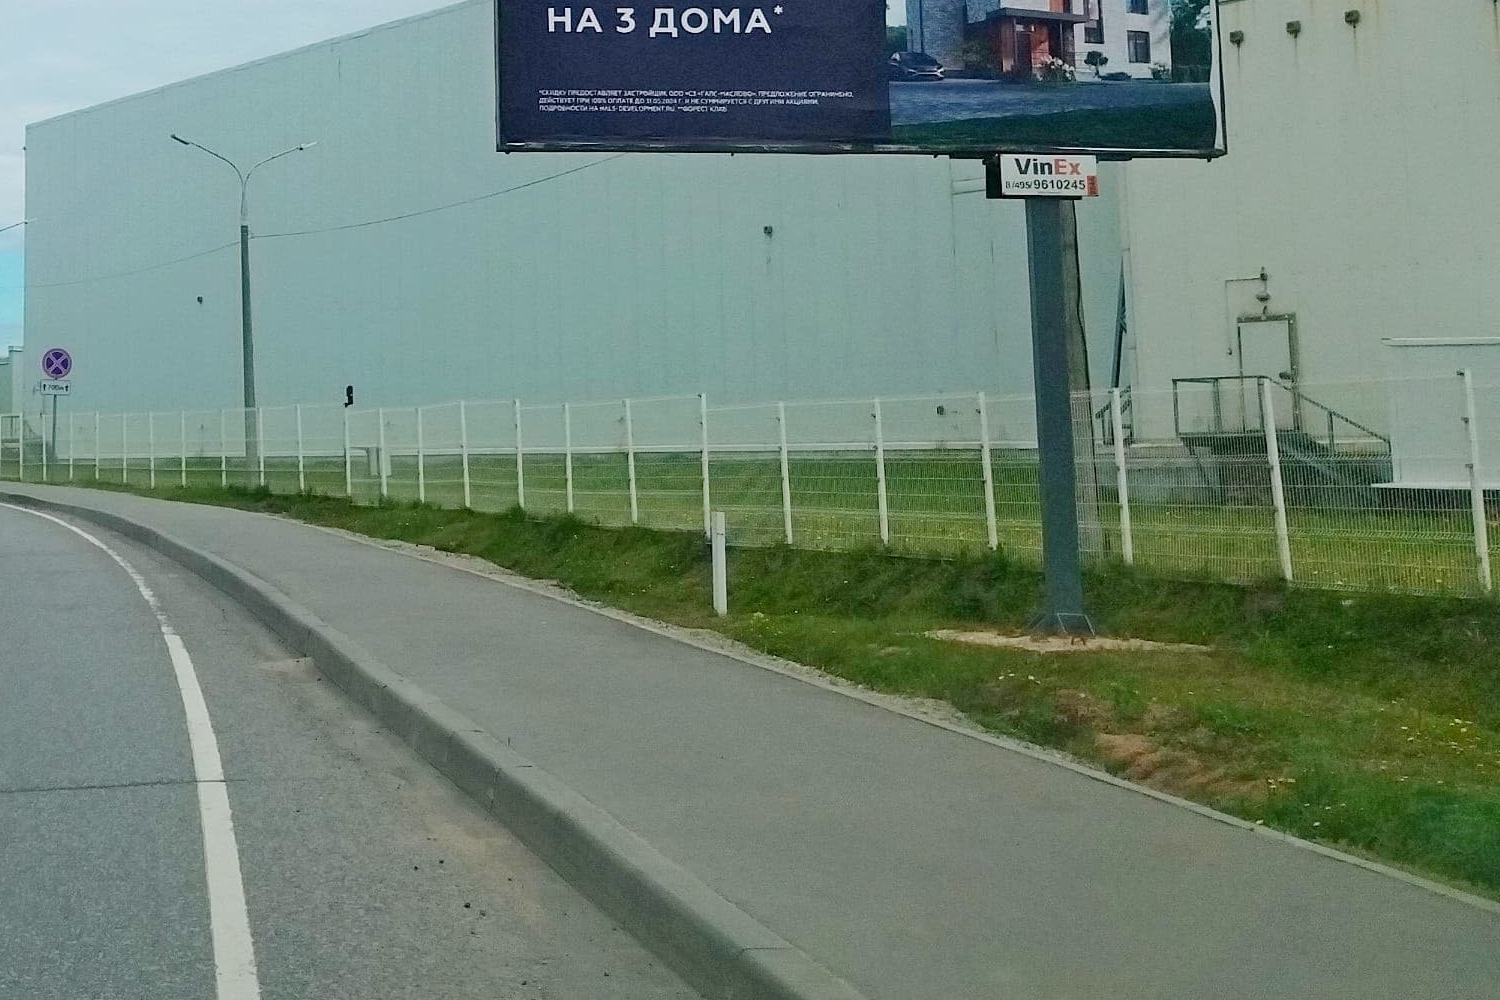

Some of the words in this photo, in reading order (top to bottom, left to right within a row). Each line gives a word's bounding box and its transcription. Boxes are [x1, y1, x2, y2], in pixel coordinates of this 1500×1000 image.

[547, 7, 603, 33] НА
[615, 7, 636, 34] 3
[1014, 158, 1081, 175] VinEx
[1033, 179, 1086, 190] 9610245
